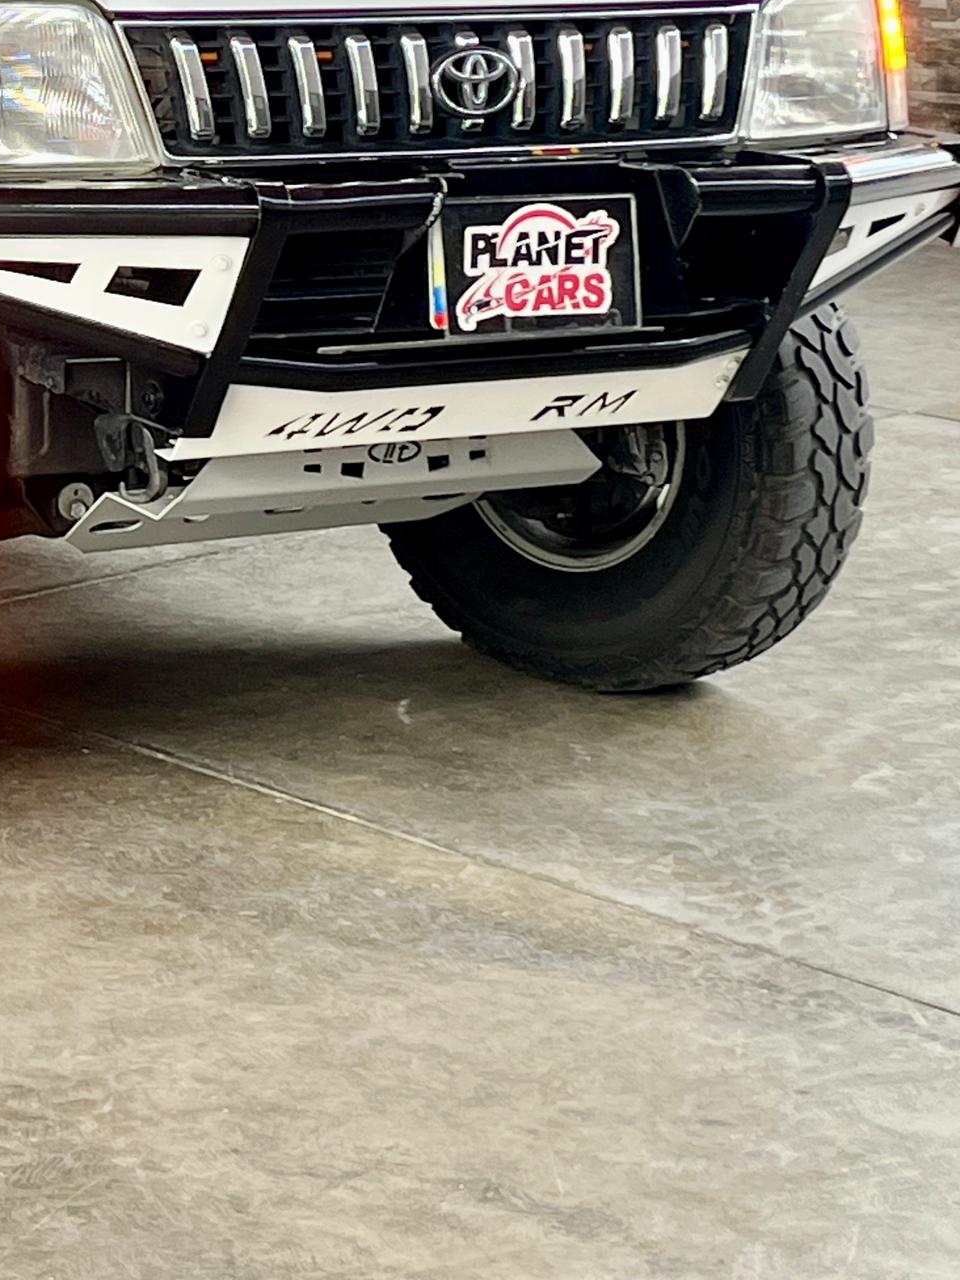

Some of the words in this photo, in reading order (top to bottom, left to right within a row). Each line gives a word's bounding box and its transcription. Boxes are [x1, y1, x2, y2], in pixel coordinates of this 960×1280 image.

[471, 228, 609, 269] PLANET
[505, 273, 605, 311] CARS
[529, 389, 639, 422] RM
